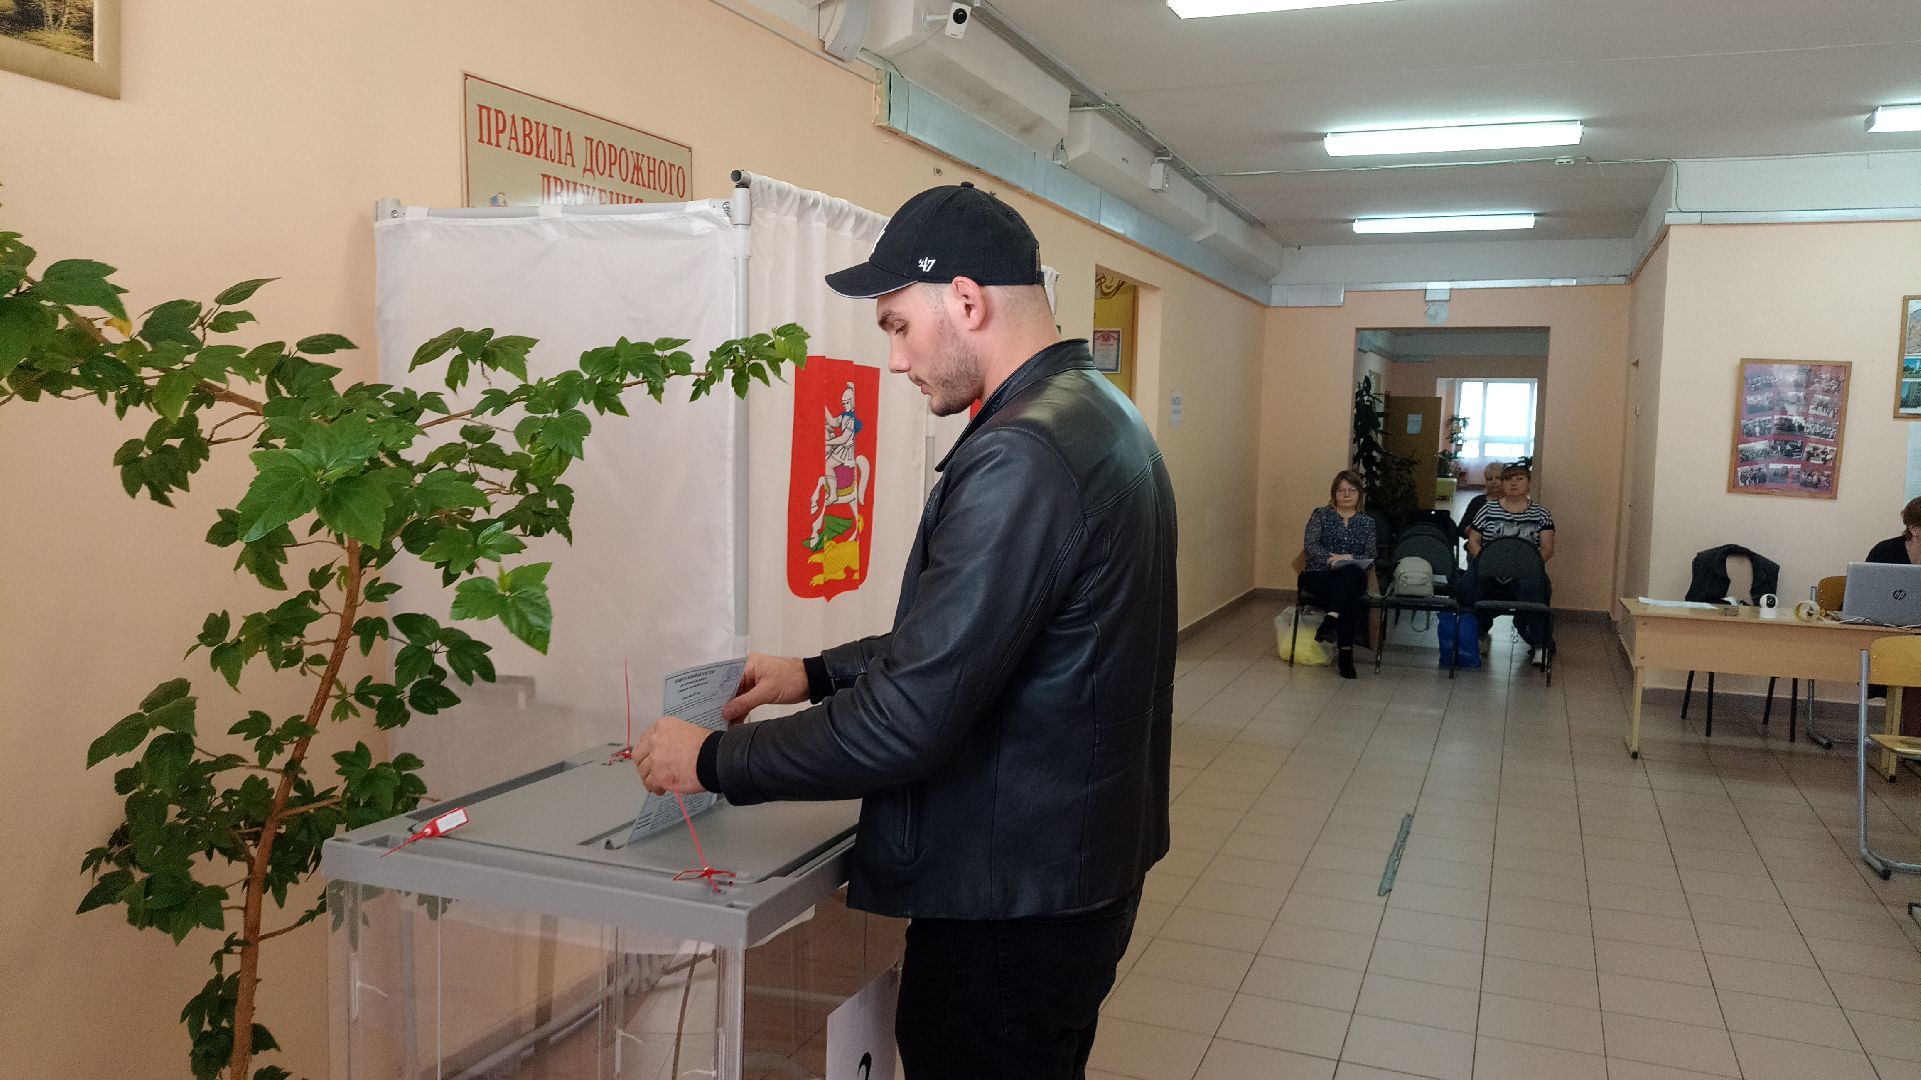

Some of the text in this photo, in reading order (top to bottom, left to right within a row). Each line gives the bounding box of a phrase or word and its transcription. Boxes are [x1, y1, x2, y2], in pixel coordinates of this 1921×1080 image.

[477, 103, 686, 199] ПРАВИЛА ДОРОЖНОГО
[540, 173, 644, 205] ДВИЖ
